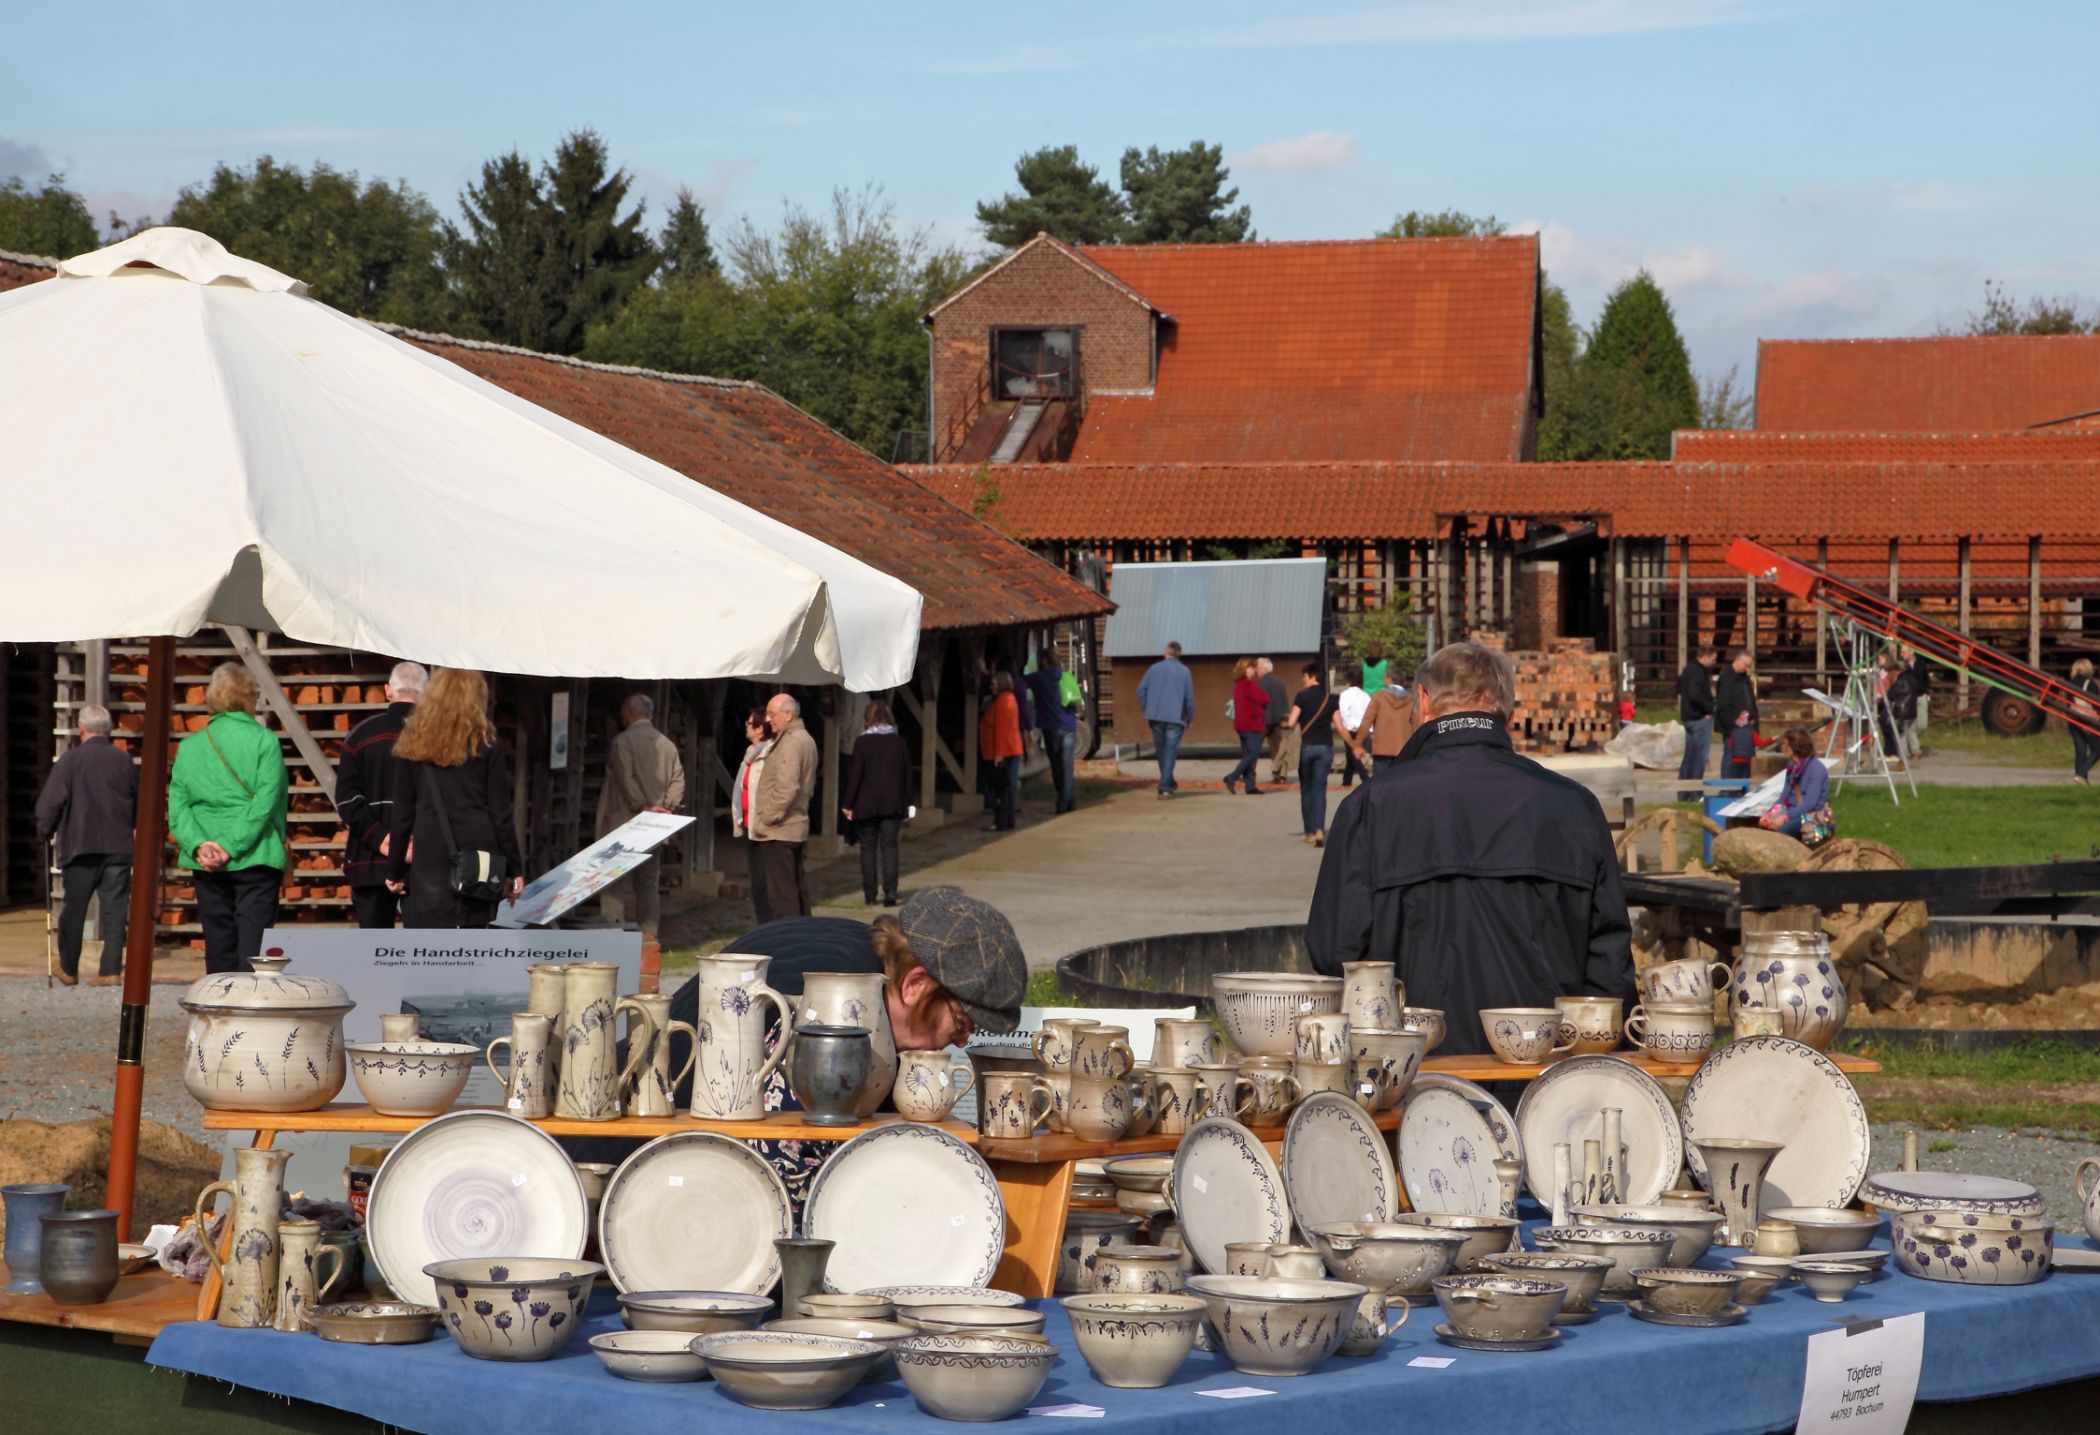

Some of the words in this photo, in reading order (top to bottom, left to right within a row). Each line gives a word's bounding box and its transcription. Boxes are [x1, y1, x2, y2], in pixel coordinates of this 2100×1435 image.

[375, 947, 406, 958] Die
[413, 947, 588, 960] Handstrichziegelei
[1846, 1361, 1883, 1383] Töpferei
[1841, 1384, 1880, 1403] Humpert
[1830, 1407, 1852, 1420] 44793
[1855, 1402, 1884, 1416] Bochum
